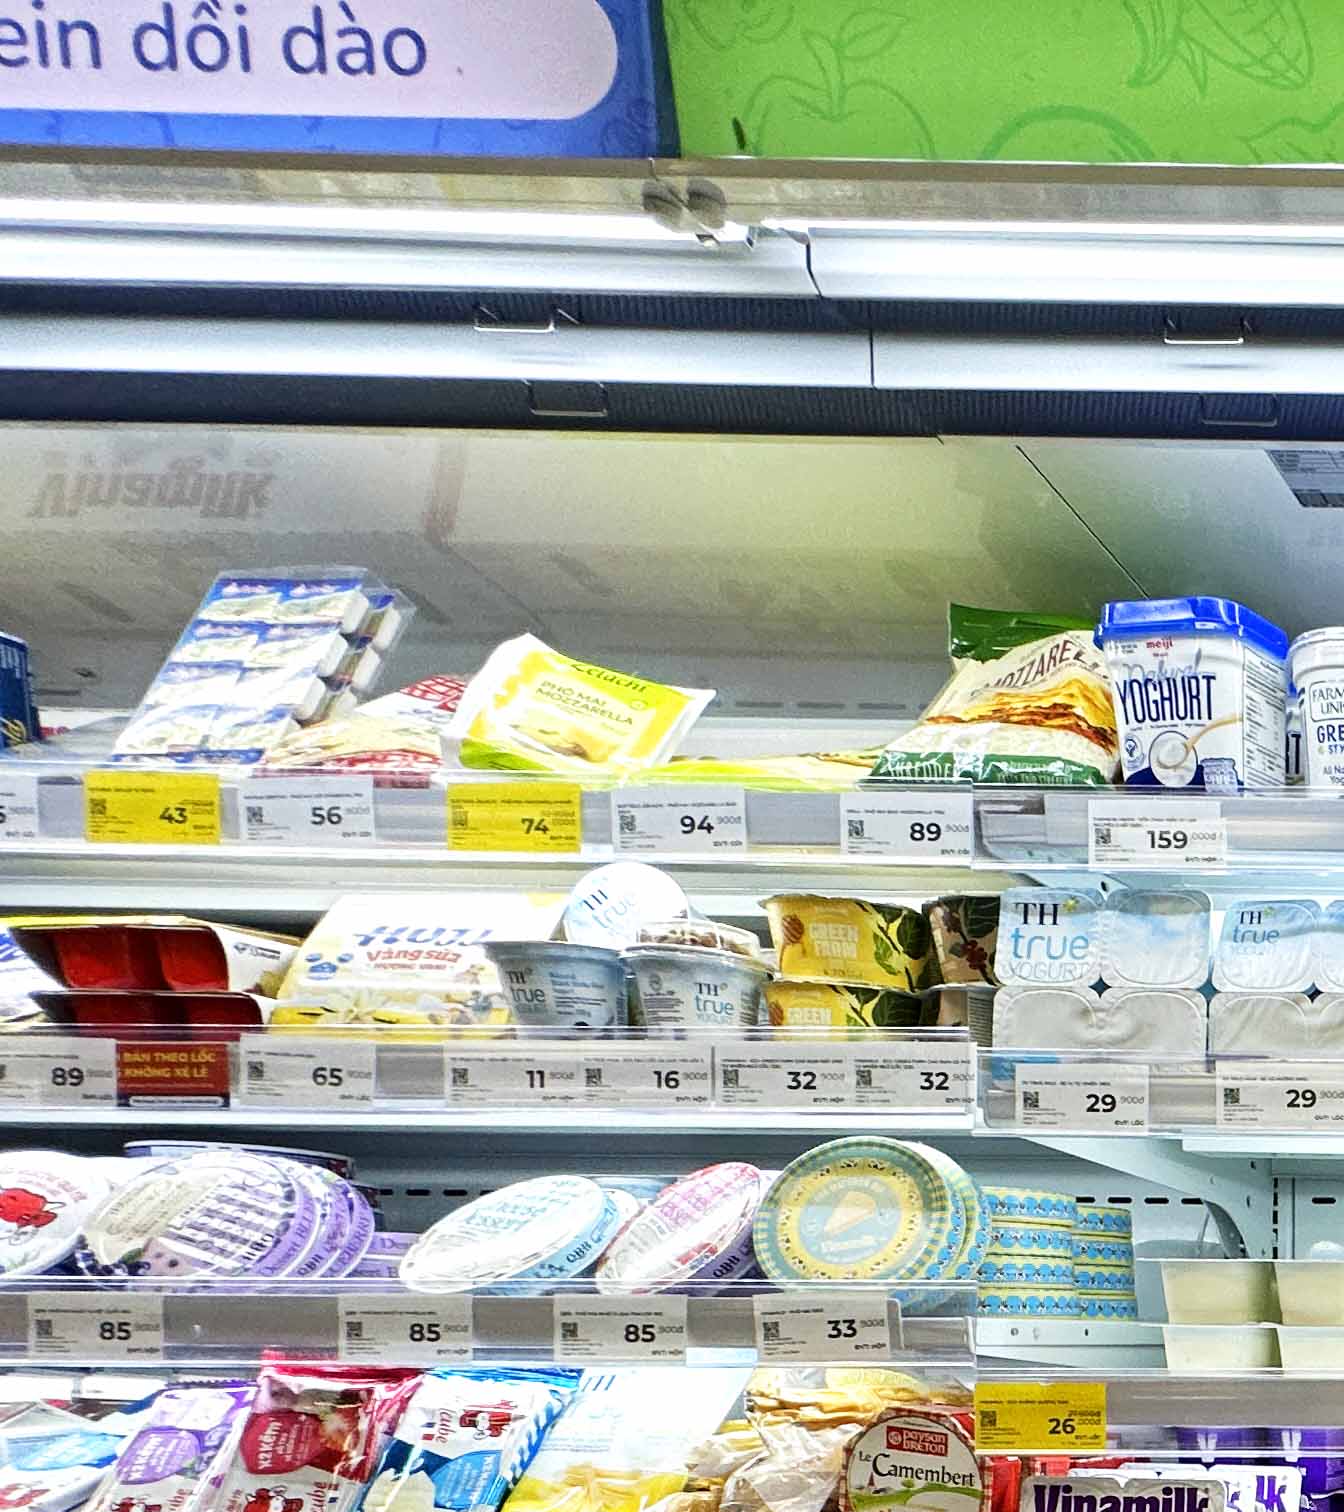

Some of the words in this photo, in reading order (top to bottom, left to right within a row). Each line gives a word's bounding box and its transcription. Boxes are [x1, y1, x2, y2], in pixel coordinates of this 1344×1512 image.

[133, 0, 251, 74] dồi
[281, 2, 428, 76] dào
[1116, 672, 1216, 725] YOGHURT
[1015, 901, 1060, 926] TH
[1009, 926, 1090, 963] true
[870, 1451, 977, 1488] Camembert
